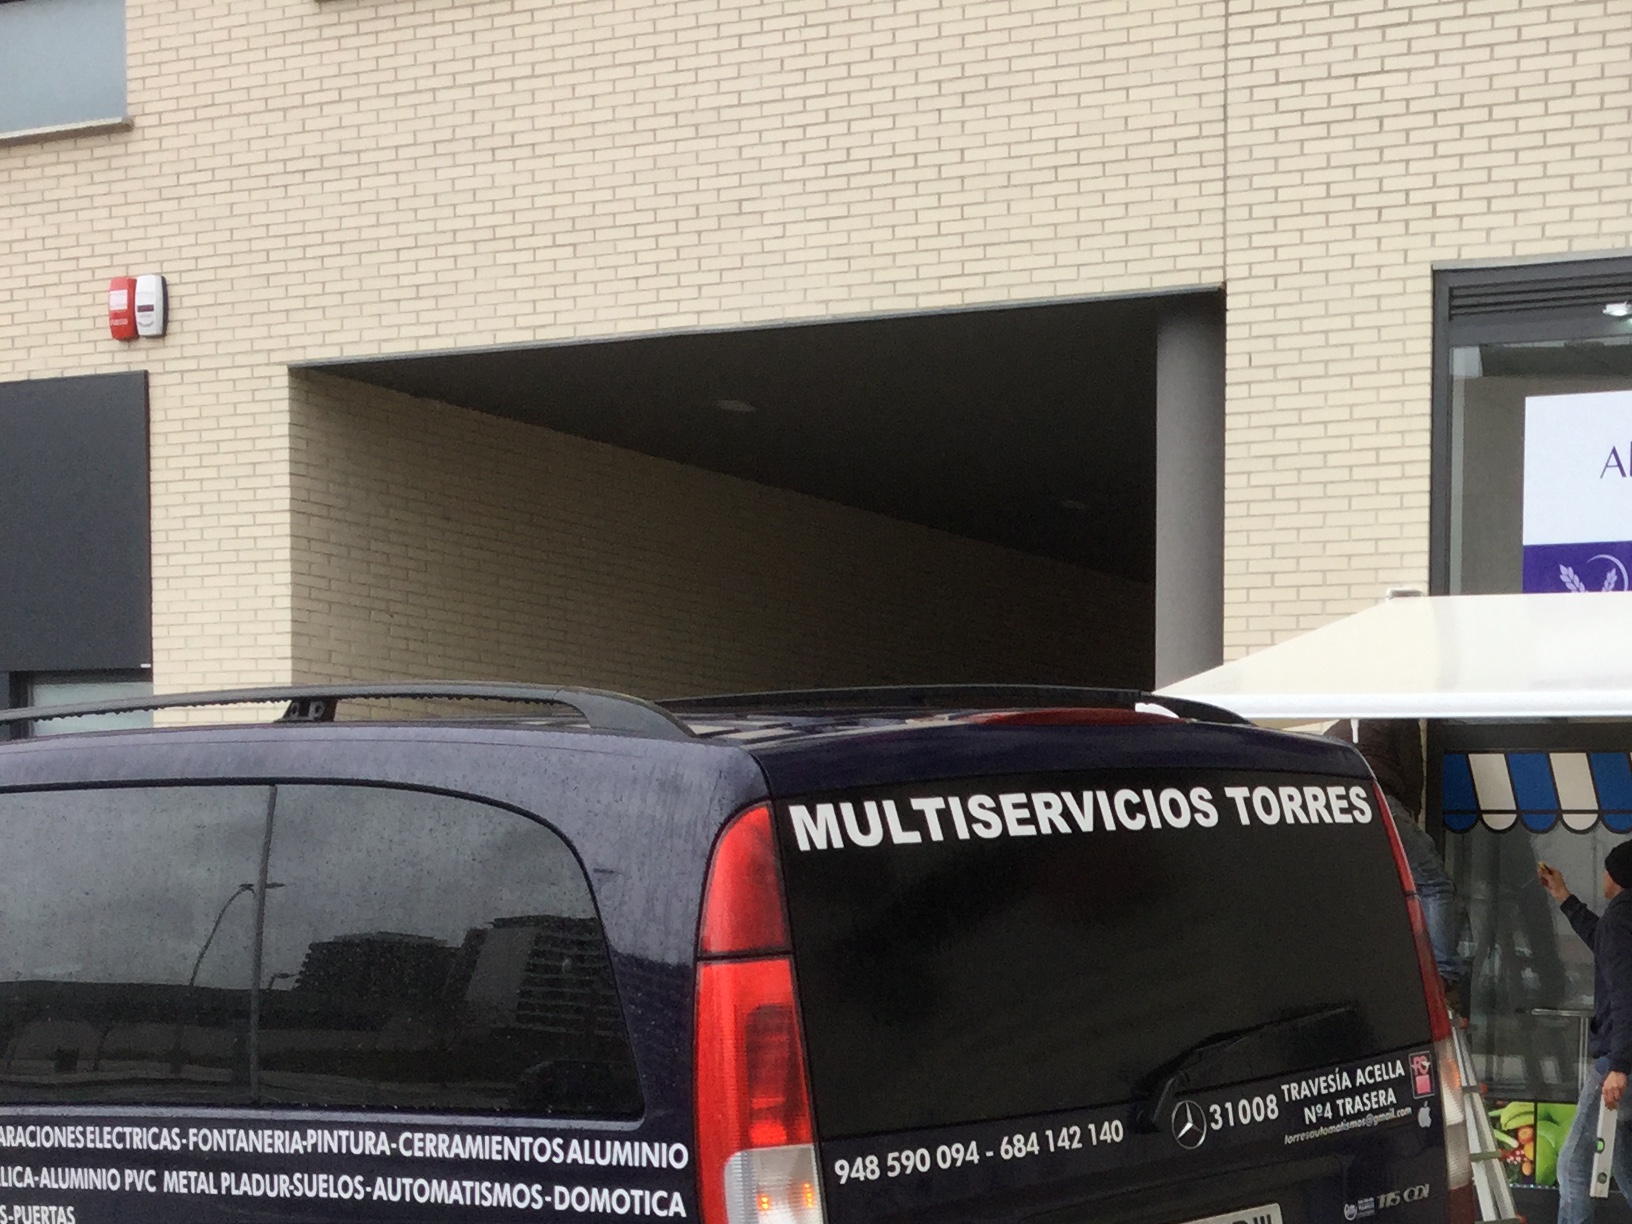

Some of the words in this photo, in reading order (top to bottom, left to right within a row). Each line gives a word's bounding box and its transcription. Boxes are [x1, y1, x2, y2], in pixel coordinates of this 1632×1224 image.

[789, 787, 1218, 851] MULTISERVICIOS
[1225, 786, 1372, 827] TORRES
[1281, 1067, 1352, 1102] TRAVESÍA
[1356, 1059, 1405, 1087] ACELLA
[1209, 1094, 1279, 1131] 31008
[1336, 1088, 1397, 1117] TRASERA
[1284, 1106, 1412, 1145] torresautomatismos@gmail.com
[566, 1139, 689, 1169] ALUMINIO
[834, 1155, 880, 1184] 948
[886, 1148, 931, 1177] 590
[936, 1141, 980, 1170] 094
[1000, 1132, 1040, 1160] 684
[1045, 1125, 1083, 1152] 142
[1088, 1120, 1124, 1146] 140
[0, 1166, 120, 1191] LICA-ALUMINIO
[124, 1169, 156, 1192] PVC
[163, 1170, 218, 1195] METAL
